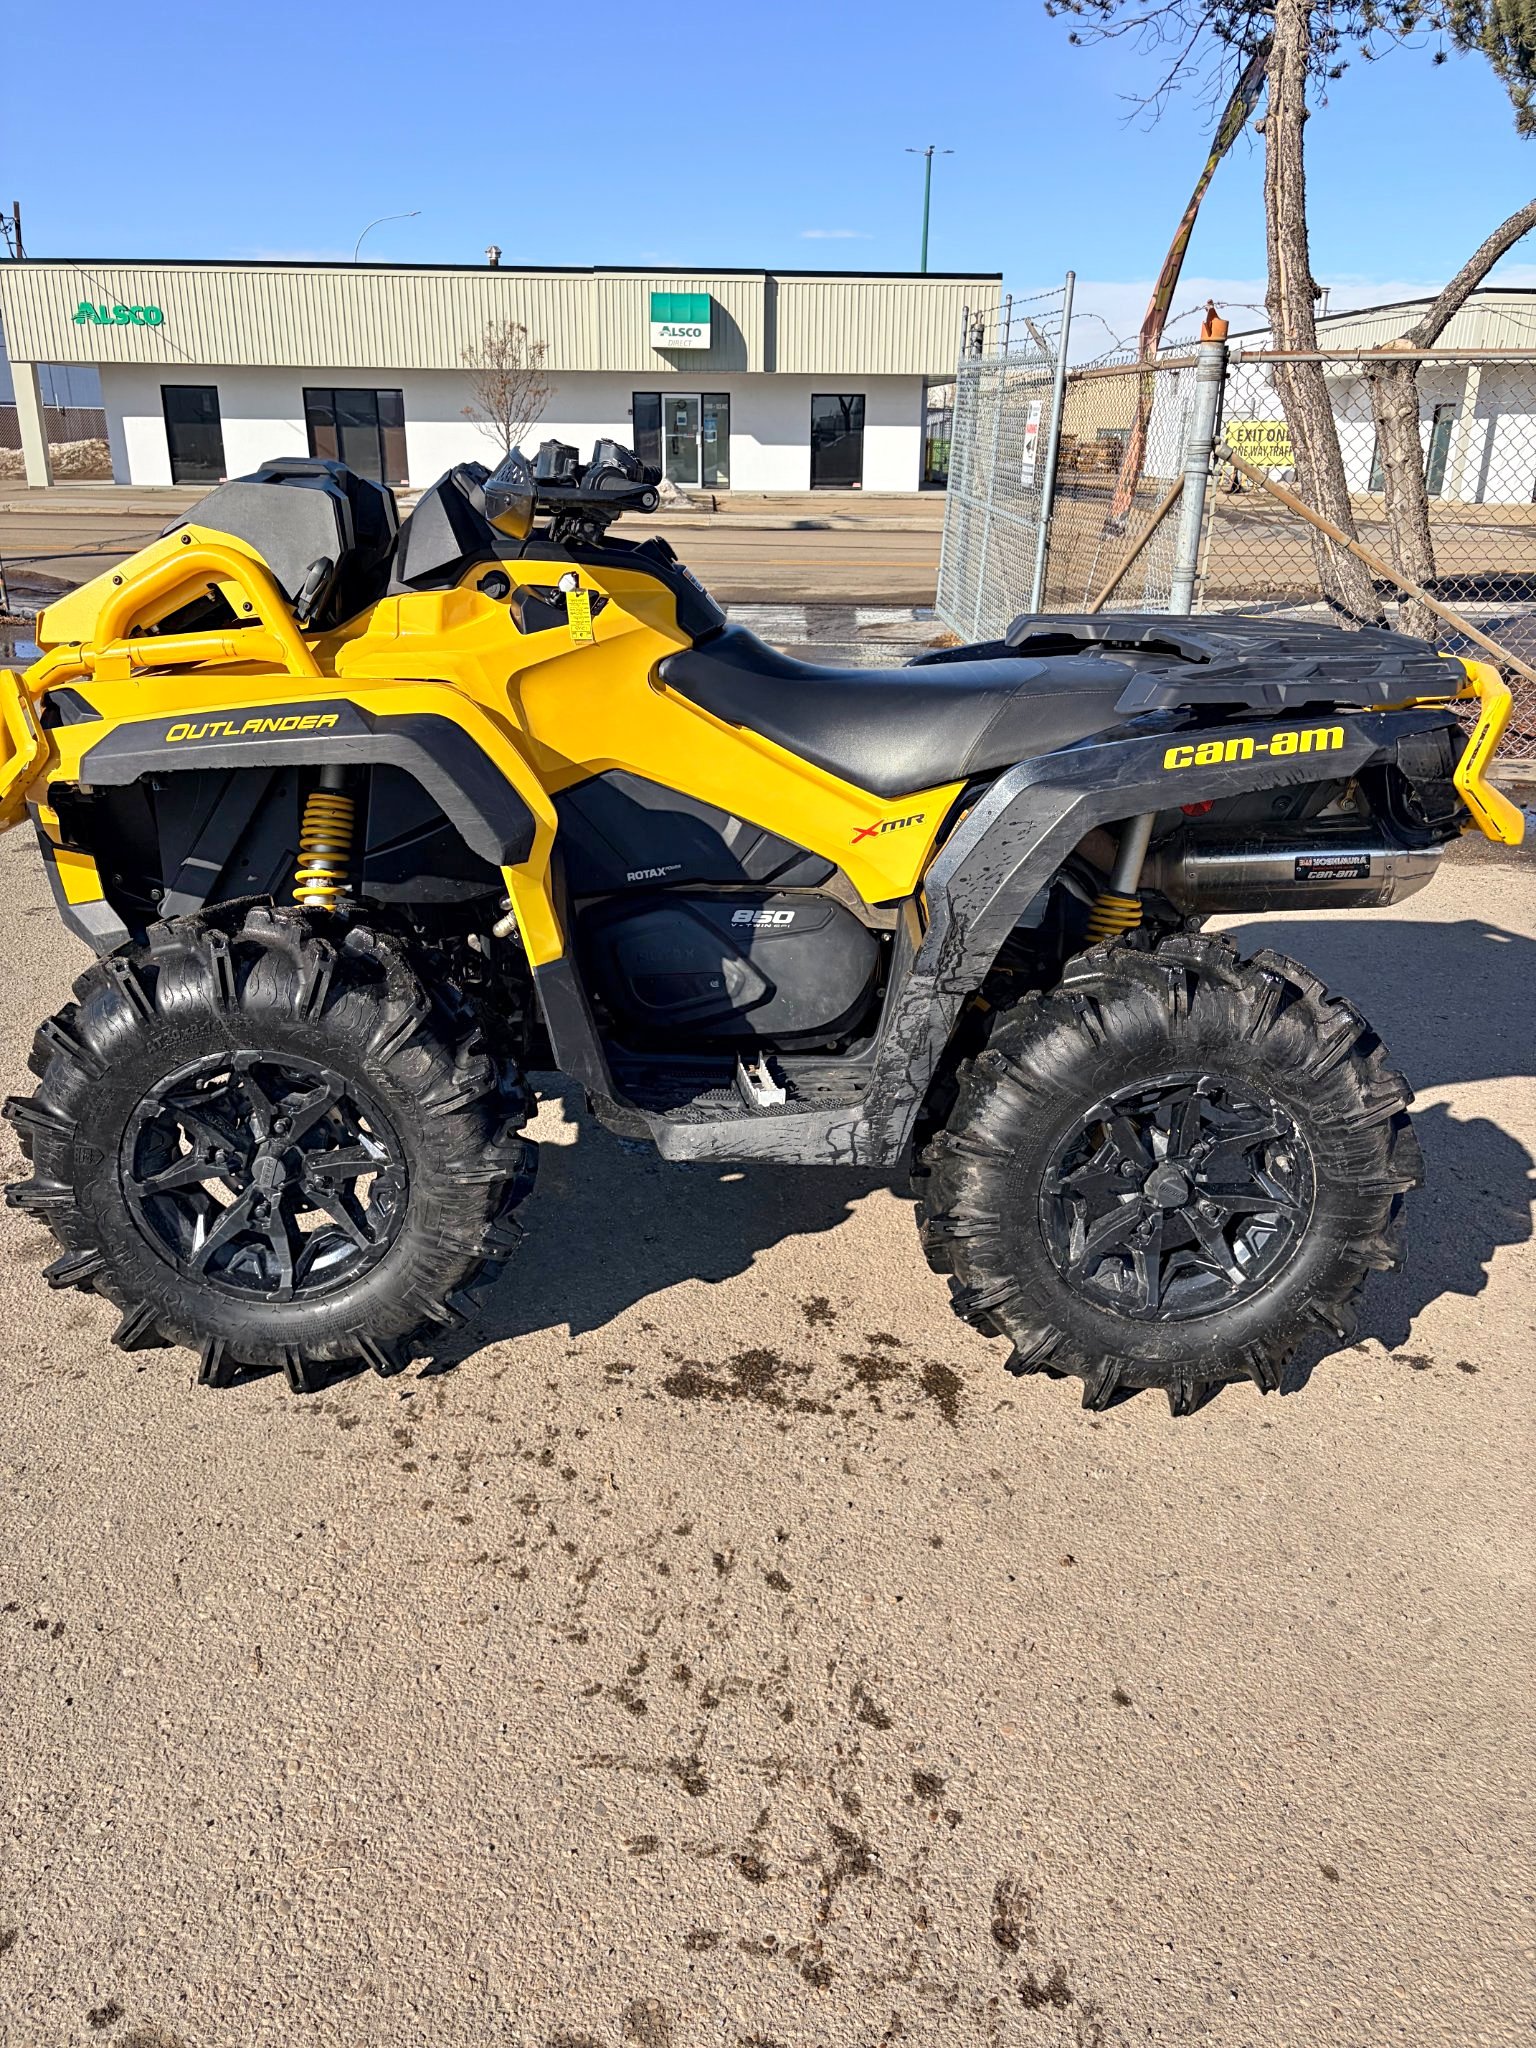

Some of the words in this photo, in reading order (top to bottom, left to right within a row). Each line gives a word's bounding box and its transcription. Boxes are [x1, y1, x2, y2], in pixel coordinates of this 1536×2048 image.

[71, 302, 163, 326] ALSCO
[658, 326, 702, 337] ALSCO
[1238, 429, 1263, 442] EXIT
[1232, 446, 1248, 456] ONE
[1250, 446, 1268, 456] WAY
[166, 714, 339, 742] OUTLANDER
[1163, 726, 1345, 770] can-am
[626, 867, 666, 881] ROTAX
[1307, 869, 1358, 879] can-am
[731, 910, 795, 924] 850
